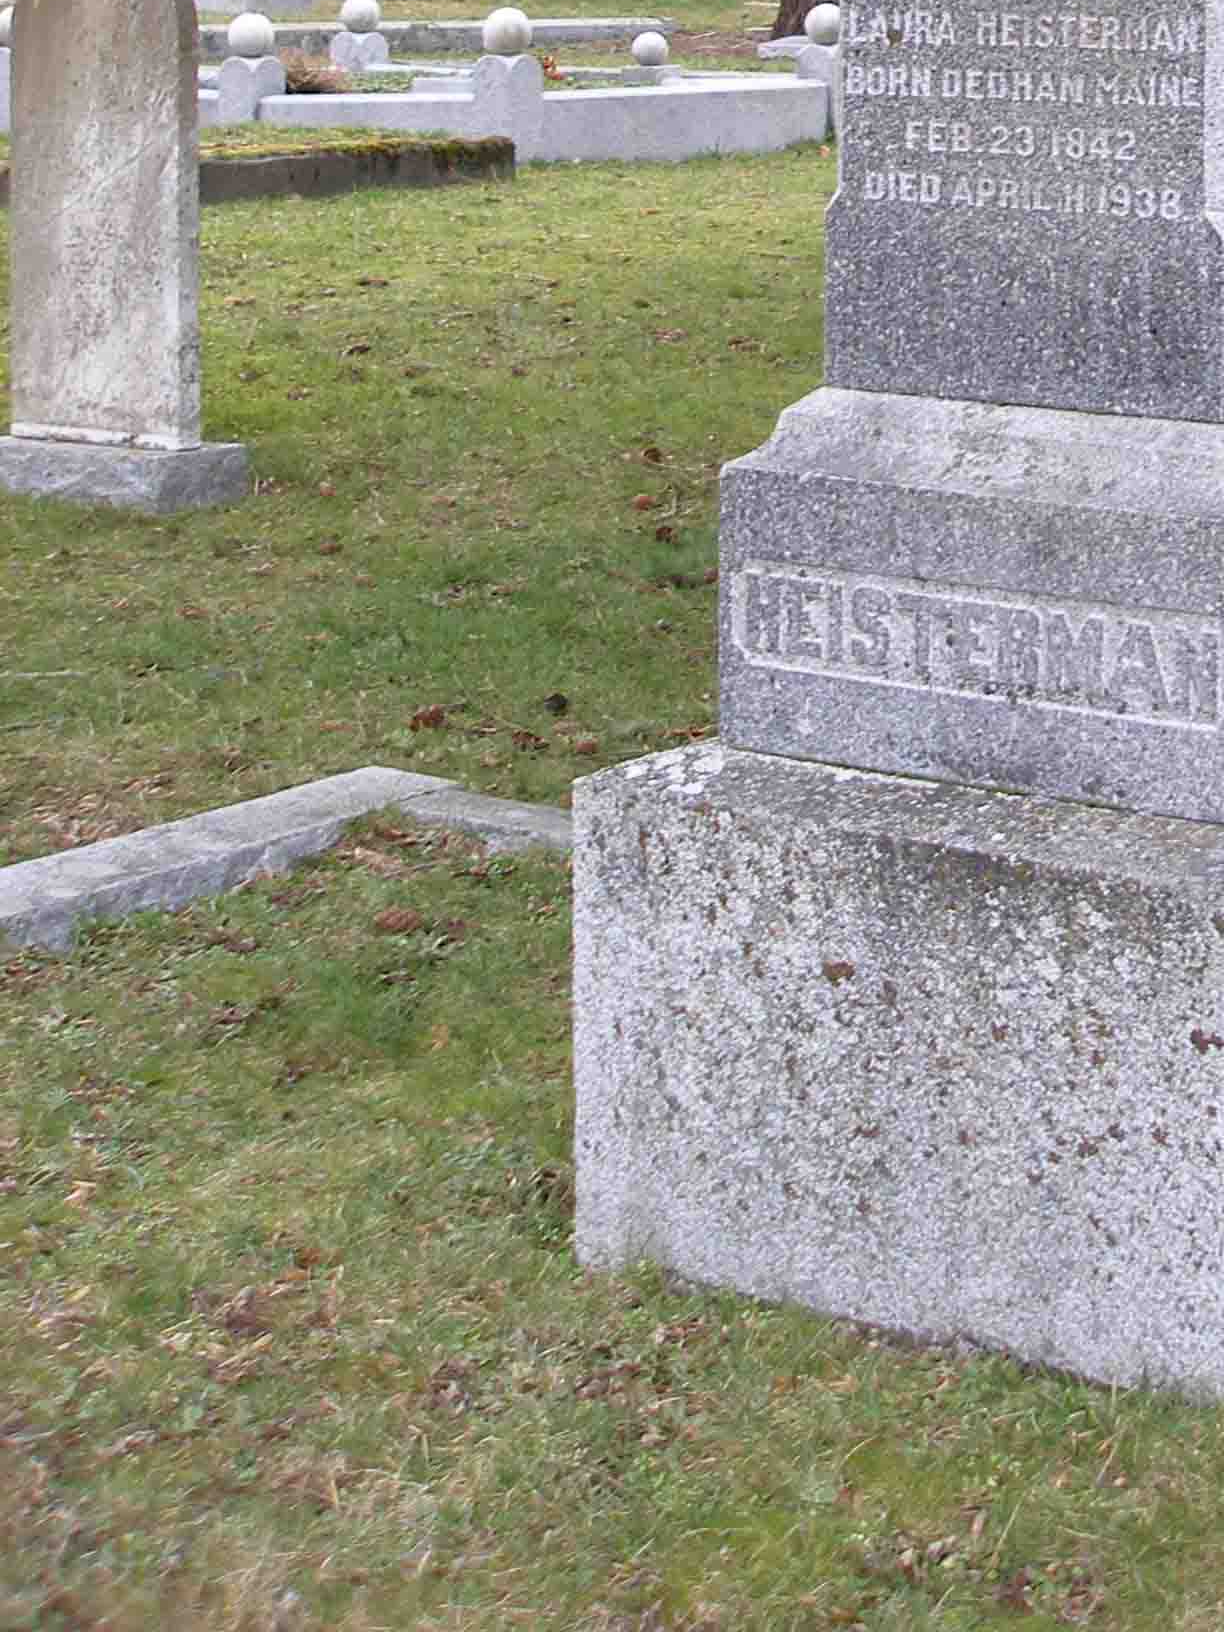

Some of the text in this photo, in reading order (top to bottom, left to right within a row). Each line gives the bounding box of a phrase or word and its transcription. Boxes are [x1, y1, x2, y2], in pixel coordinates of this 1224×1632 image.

[846, 9, 1203, 54] LAURA HEISTERMAN
[846, 67, 1203, 108] BORN DEDHAM MAINE
[990, 125, 1035, 158] 23
[1051, 127, 1137, 162] 1842
[863, 171, 942, 204] DIED
[950, 177, 1051, 212] APRIL
[745, 575, 1221, 724] HEISTERMAN
